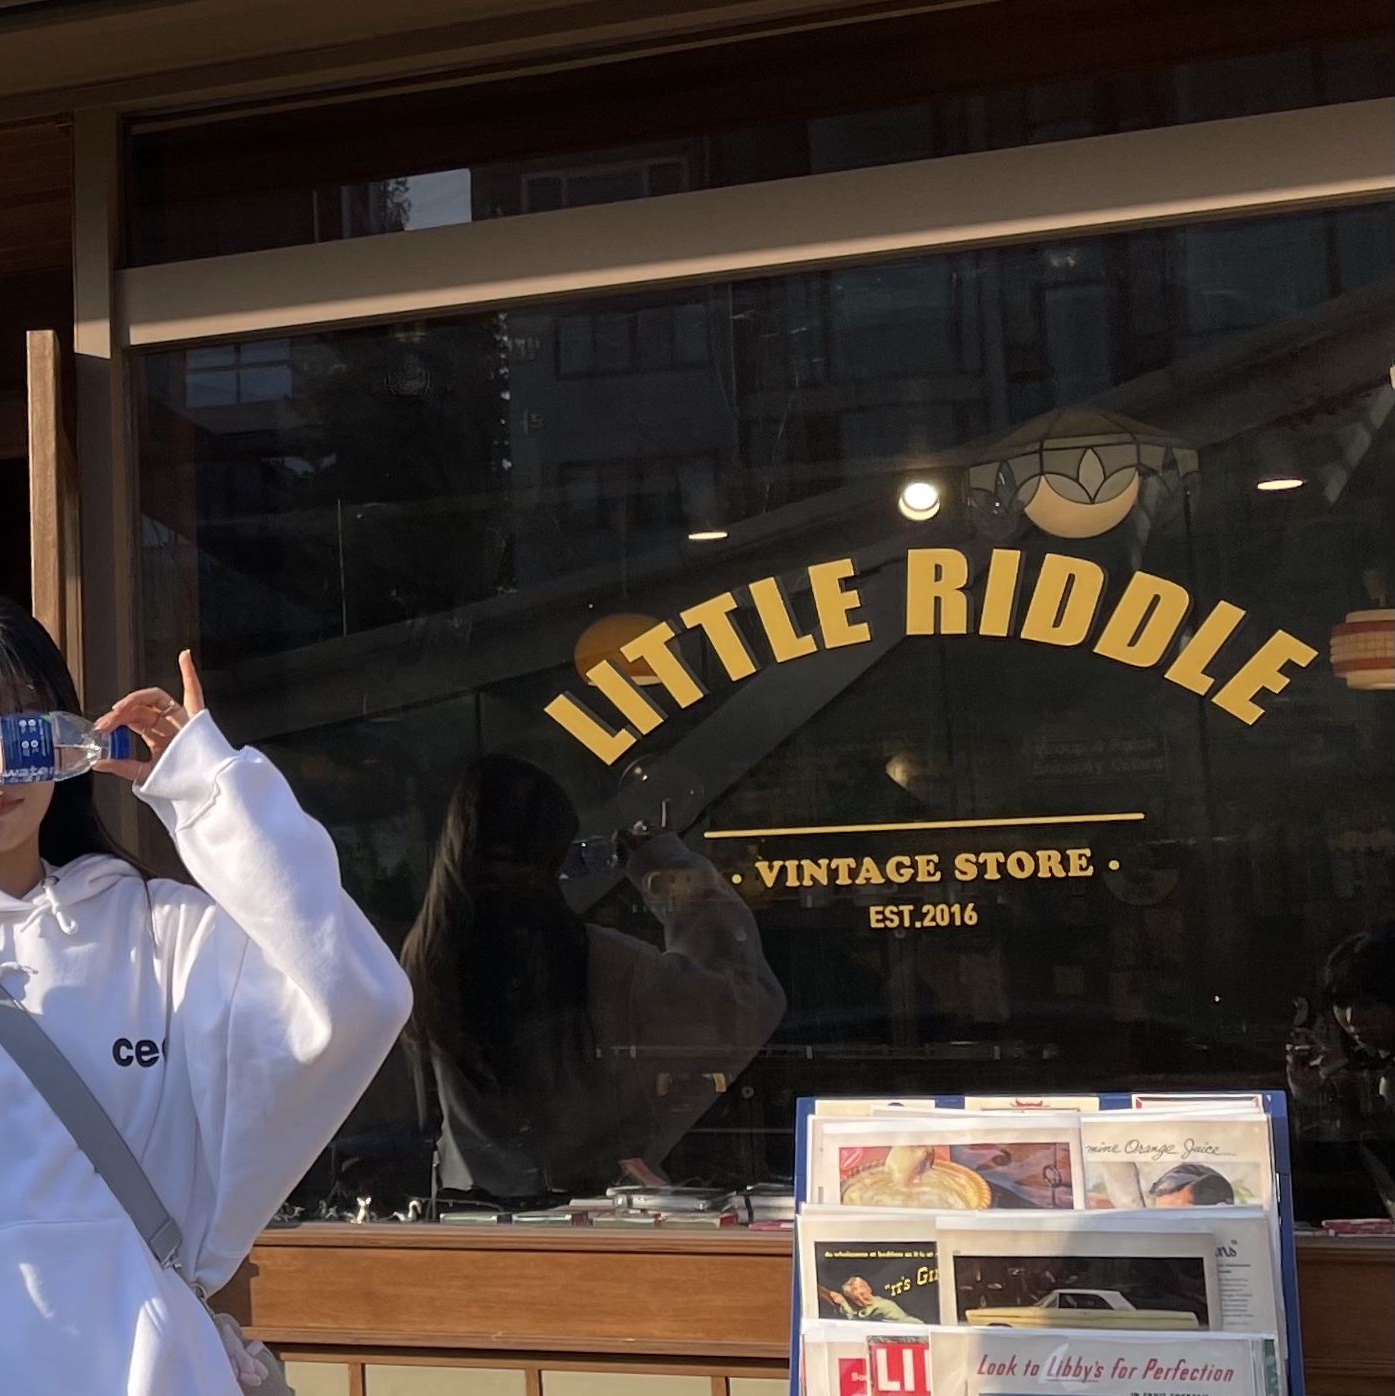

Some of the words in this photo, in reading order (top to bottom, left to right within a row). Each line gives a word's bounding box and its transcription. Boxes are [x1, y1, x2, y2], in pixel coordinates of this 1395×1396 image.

[543, 558, 871, 766] LITTLE
[906, 548, 1319, 726] RIDDLE
[754, 854, 941, 888] VINTAGE
[954, 848, 1094, 880] STORE
[869, 903, 978, 929] EST.2016
[112, 1037, 167, 1068] ce
[1124, 1139, 1178, 1161] Orange
[1181, 1138, 1227, 1159] Juice
[976, 1354, 1017, 1376] Look
[1023, 1357, 1040, 1376] to
[1046, 1355, 1104, 1383] Libby's
[1111, 1357, 1138, 1379] for
[1142, 1358, 1234, 1382] Perfection
